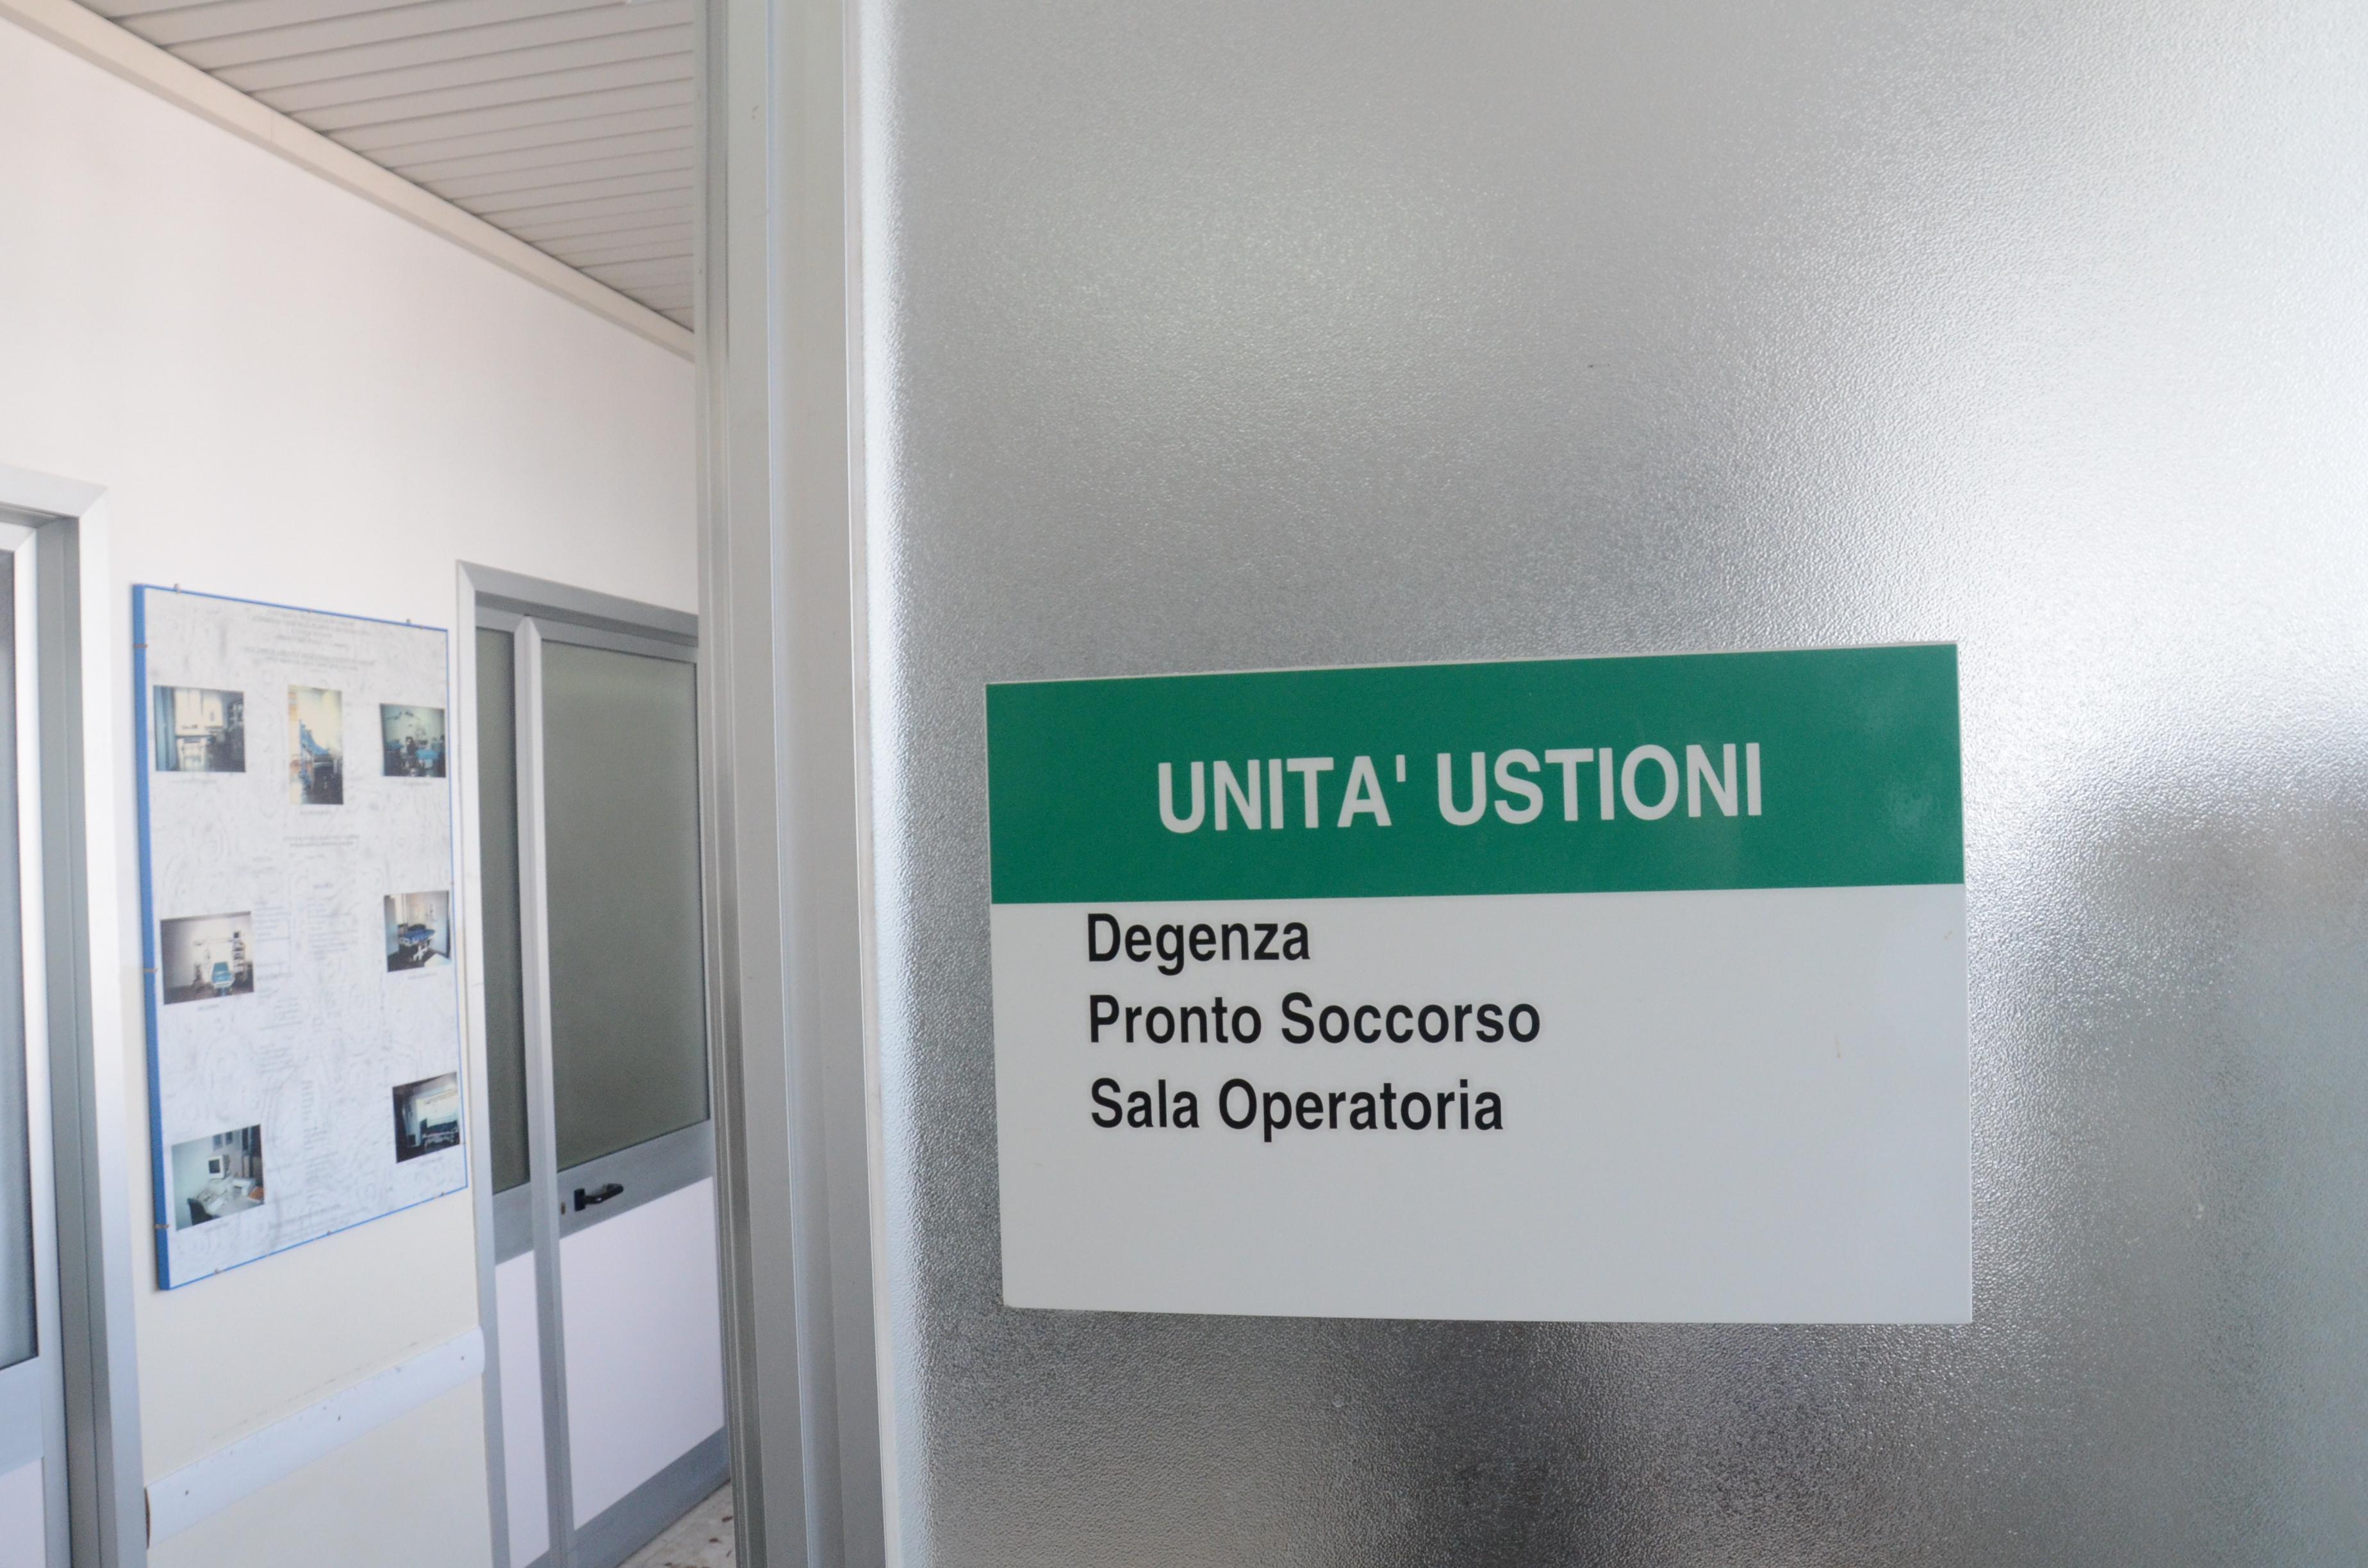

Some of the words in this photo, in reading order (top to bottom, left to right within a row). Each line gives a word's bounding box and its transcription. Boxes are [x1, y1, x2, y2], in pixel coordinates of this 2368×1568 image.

[1158, 755, 1406, 833] UNITA'
[1437, 742, 1762, 826] USTIONI
[1087, 913, 1311, 976] Degenza
[1089, 994, 1262, 1044] Pronto
[1281, 992, 1540, 1045] Soccorso
[1091, 1077, 1200, 1129] Sala
[1219, 1078, 1504, 1143] Operatoria
